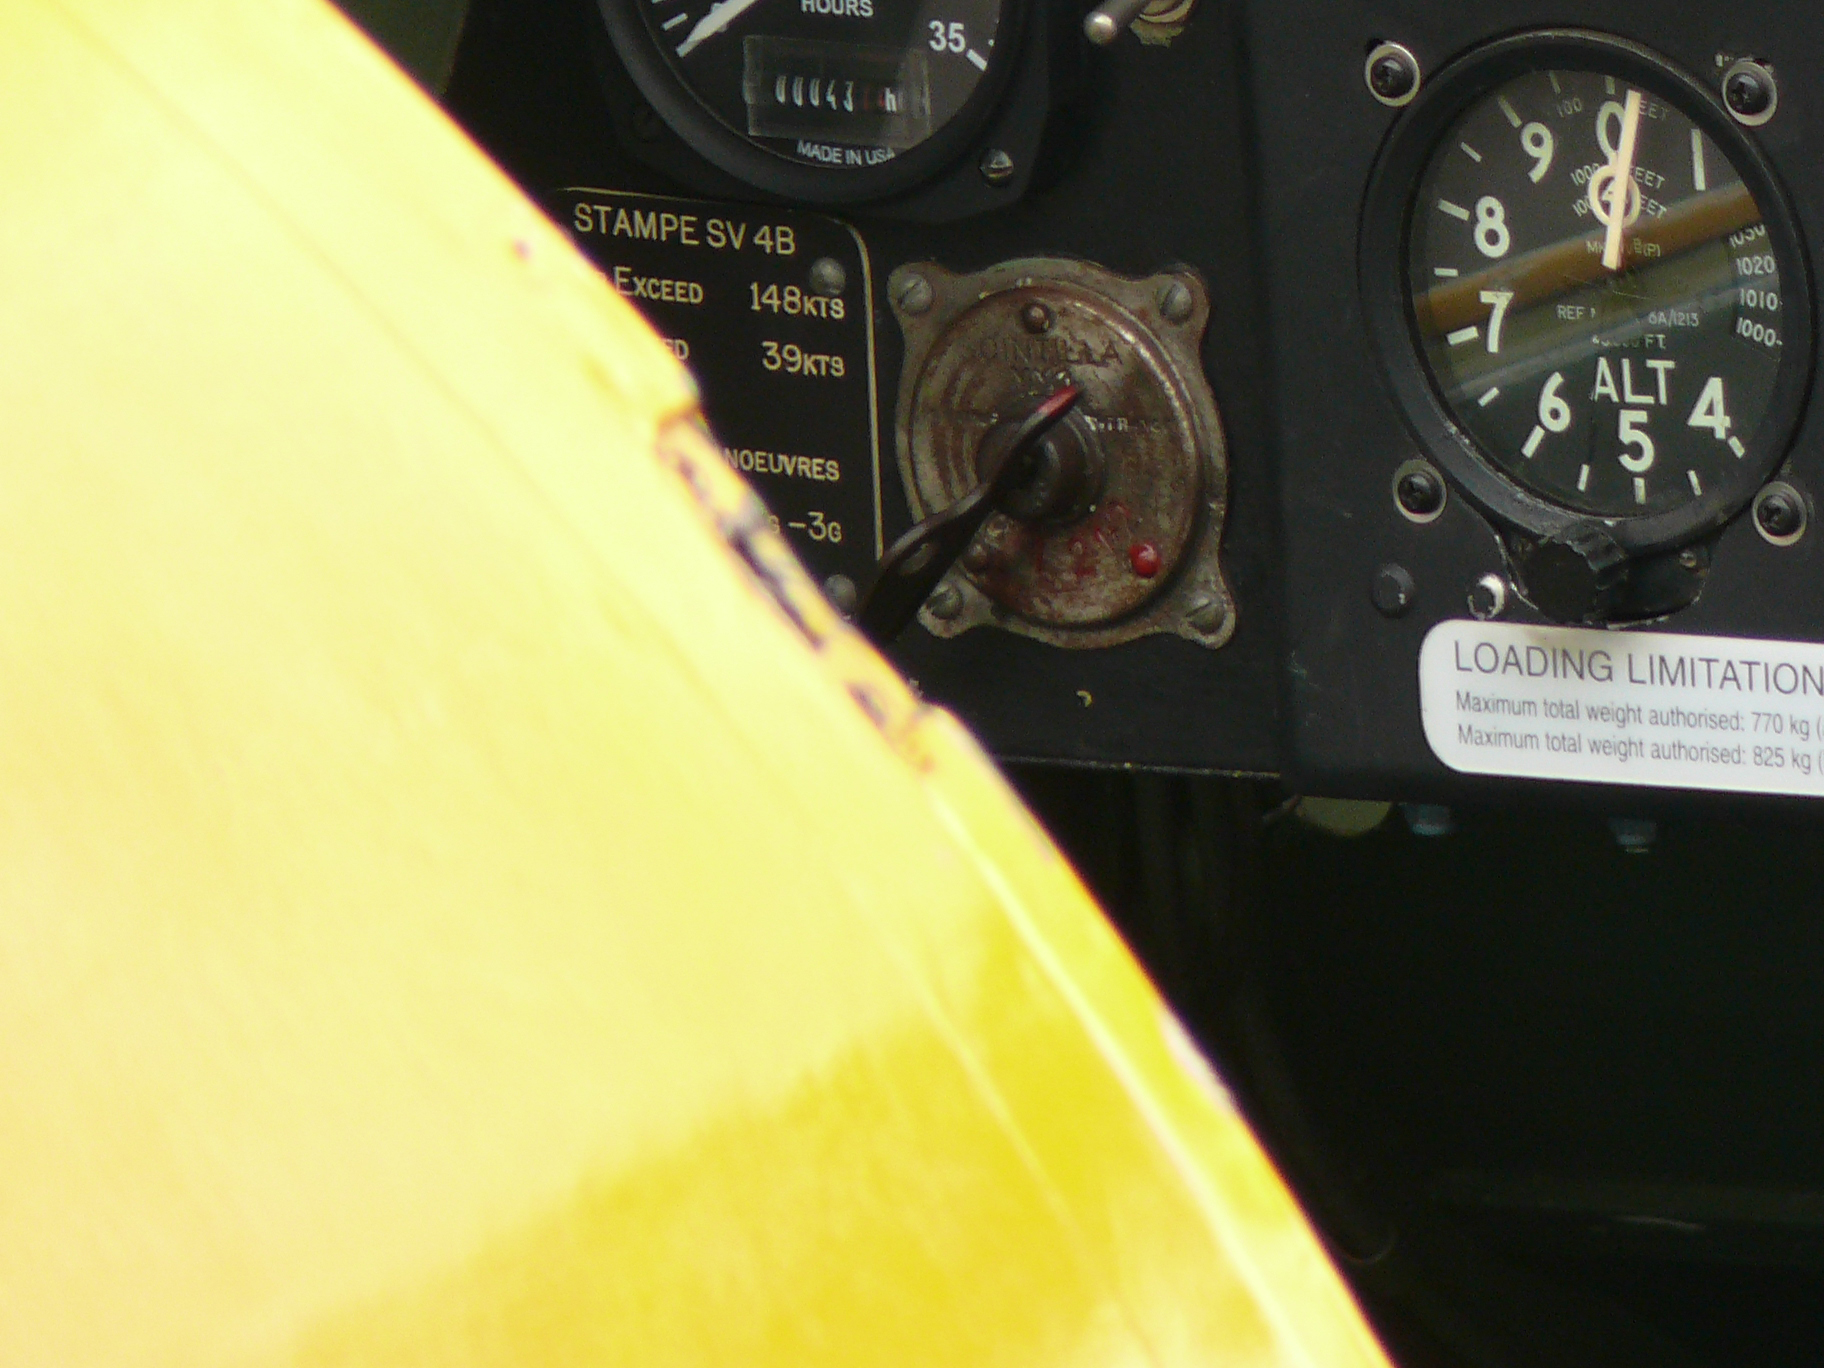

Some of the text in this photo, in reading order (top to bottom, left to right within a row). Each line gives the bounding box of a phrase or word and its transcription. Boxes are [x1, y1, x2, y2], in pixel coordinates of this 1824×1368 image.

[928, 19, 966, 54] 35
[1638, 99, 1671, 121] EET
[797, 139, 844, 166] MADE
[845, 148, 863, 166] IN
[1519, 121, 1554, 184] 9
[1631, 165, 1665, 190] EET
[573, 202, 797, 255] STAMPE SV 4B
[1473, 195, 1510, 258] 8
[1735, 254, 1776, 276] 1020
[1479, 290, 1514, 354] 7
[1557, 304, 1586, 320] REF
[1740, 288, 1779, 312] 1010
[1736, 317, 1777, 347] 1000
[1537, 371, 1572, 433] 6
[1592, 356, 1676, 406] ALT
[1687, 376, 1731, 440] 4
[724, 447, 840, 482] NOEUVRES
[1616, 409, 1656, 474] 5
[1453, 639, 1615, 683] LOADING
[1455, 689, 1538, 719] Maximum
[1542, 695, 1580, 721] total
[1585, 698, 1643, 729] weight
[1648, 702, 1746, 734] authorised:
[1750, 711, 1785, 736] 770
[1789, 712, 1812, 743] kg
[1457, 723, 1540, 752] Maximum
[1544, 728, 1582, 754] total
[1586, 731, 1646, 763] weight
[1650, 736, 1747, 766] authorised:
[1752, 745, 1786, 769] 825
[1789, 747, 1812, 776] kg
